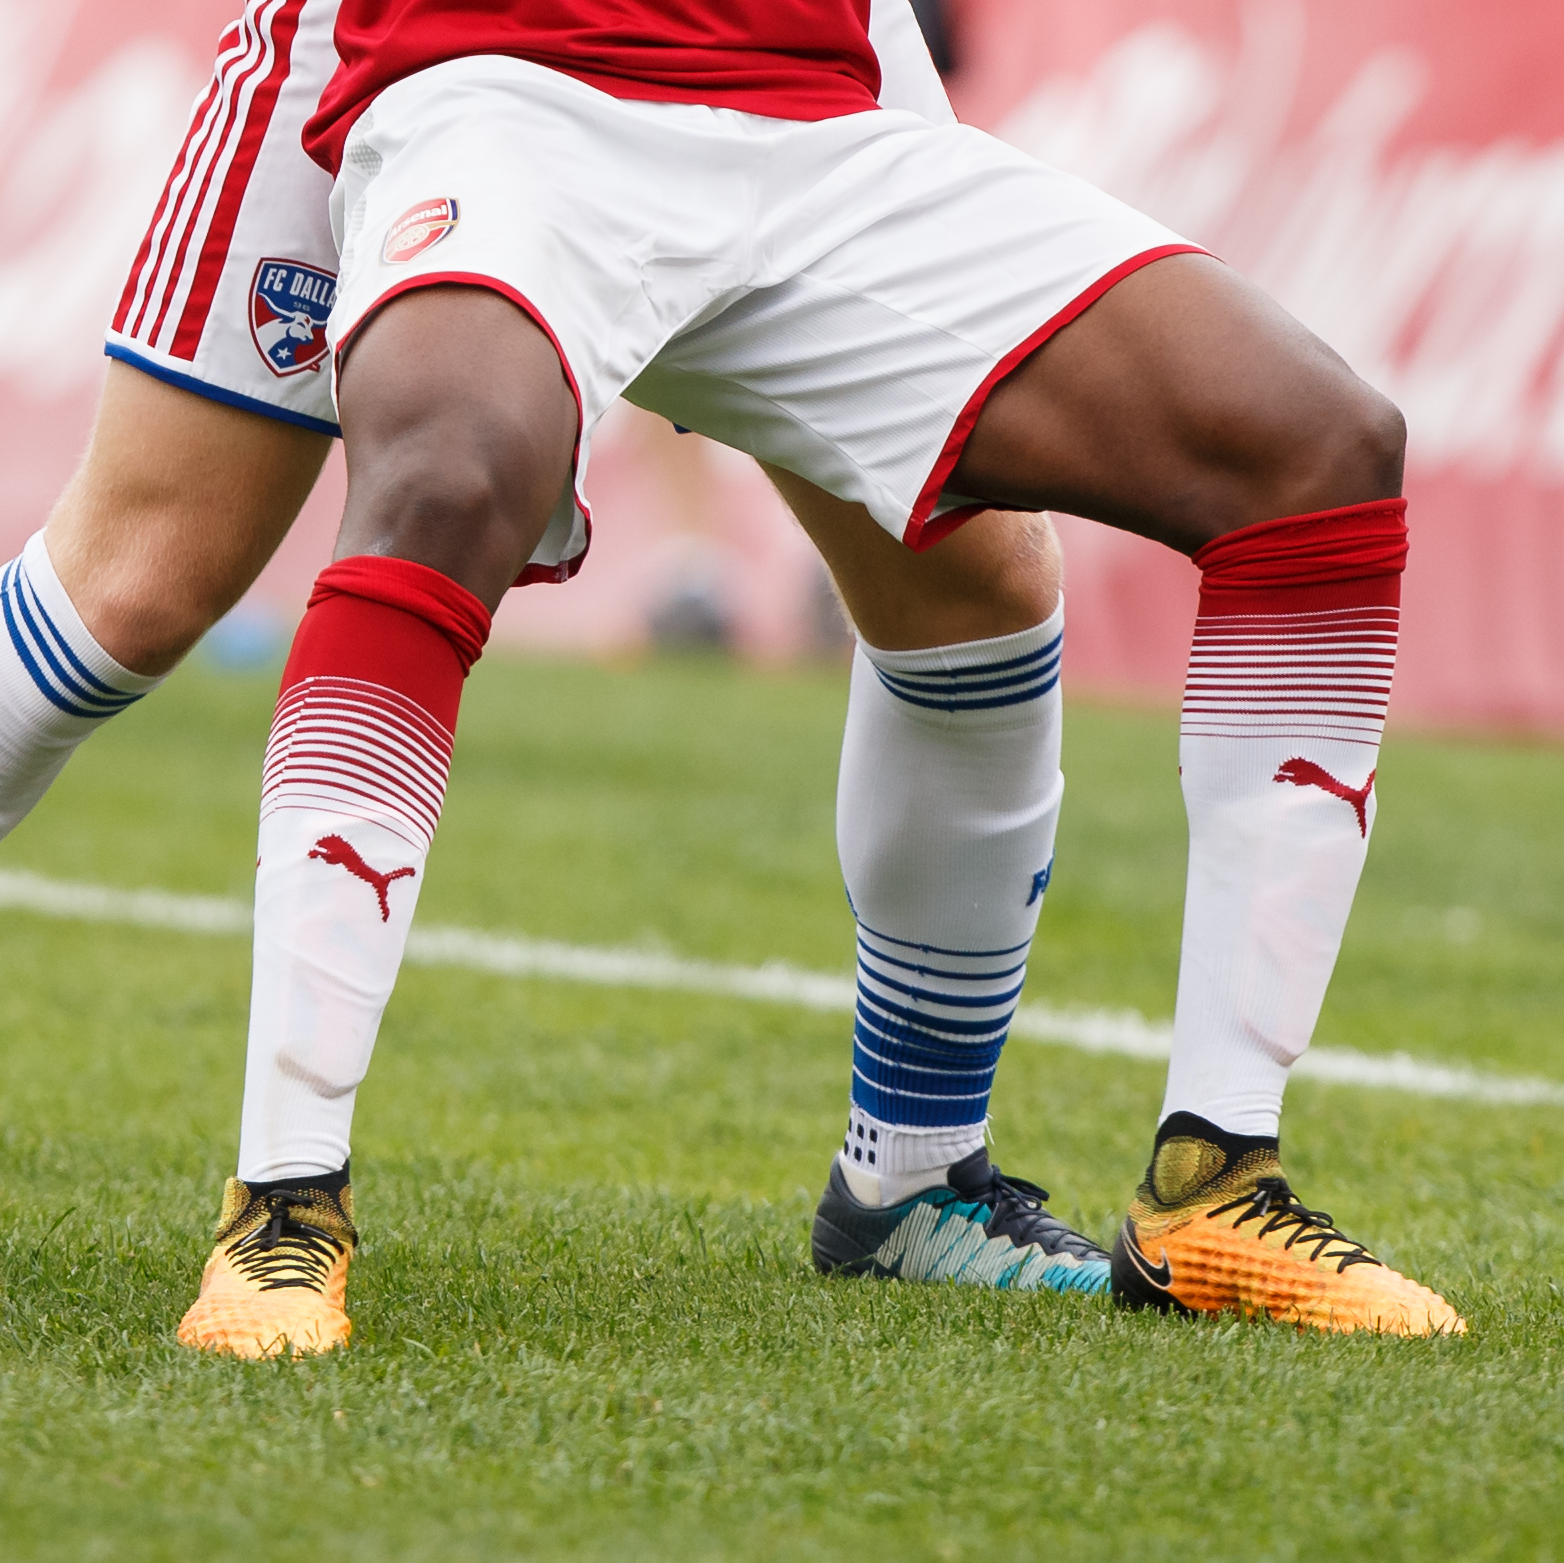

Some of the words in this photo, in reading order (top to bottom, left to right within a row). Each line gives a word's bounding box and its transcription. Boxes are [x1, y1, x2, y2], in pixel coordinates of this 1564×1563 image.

[391, 204, 448, 235] Arsenal
[263, 267, 288, 292] FC
[289, 271, 337, 309] DALLA
